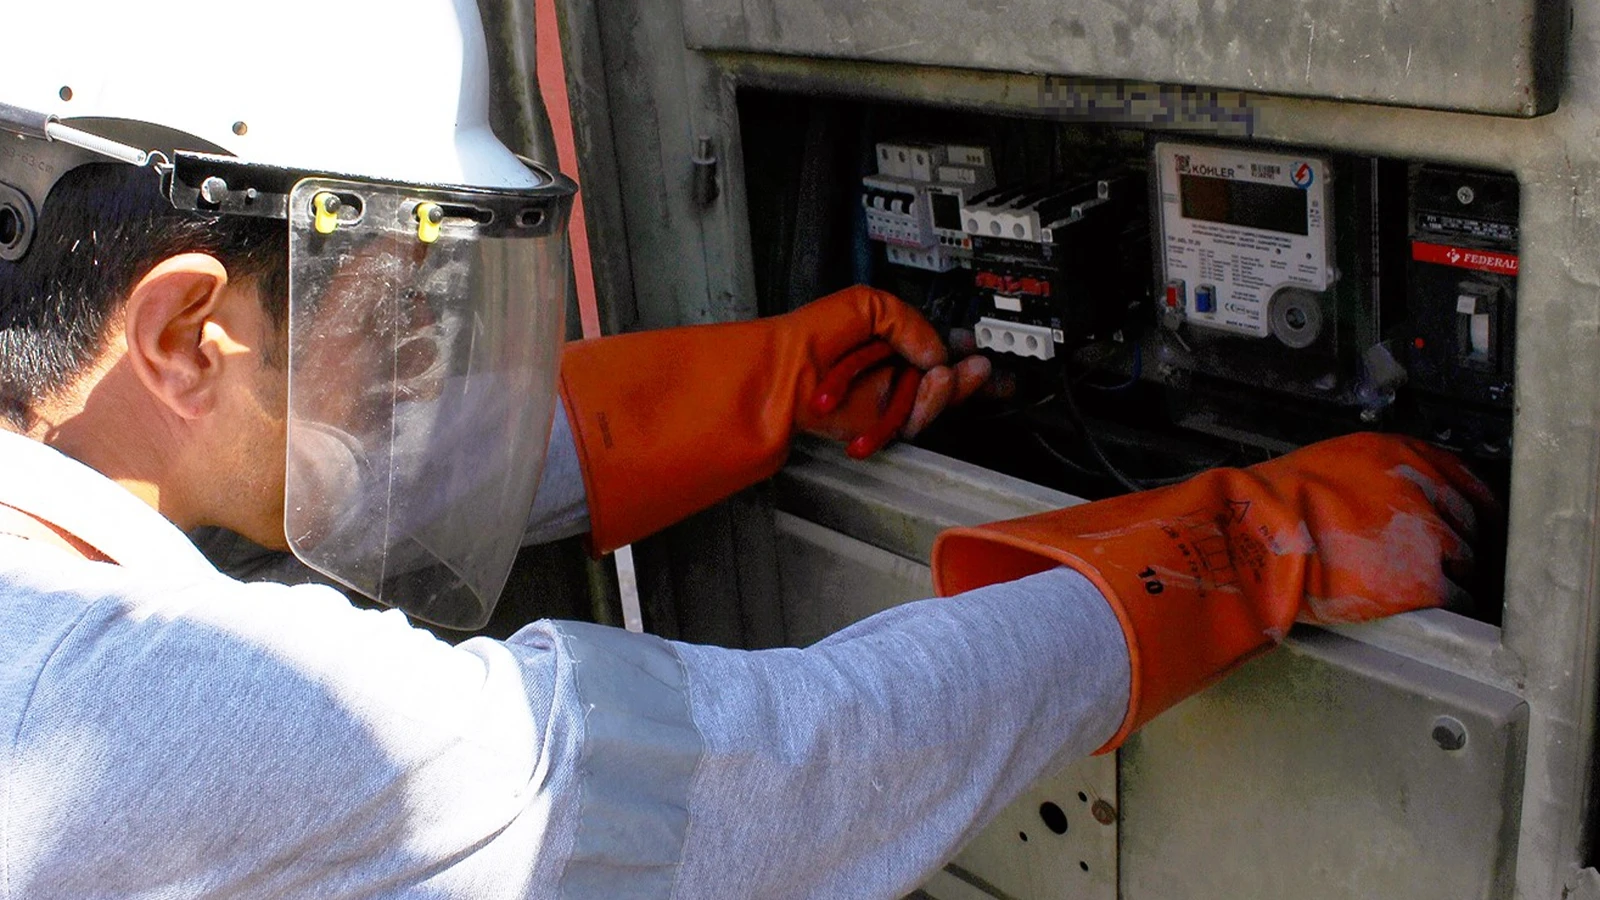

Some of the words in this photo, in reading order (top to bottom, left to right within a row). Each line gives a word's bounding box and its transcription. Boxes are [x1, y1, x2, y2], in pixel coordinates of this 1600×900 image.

[1192, 164, 1235, 178] KÖHLER
[1463, 253, 1517, 269] FEDERAL
[1138, 567, 1163, 594] 10
